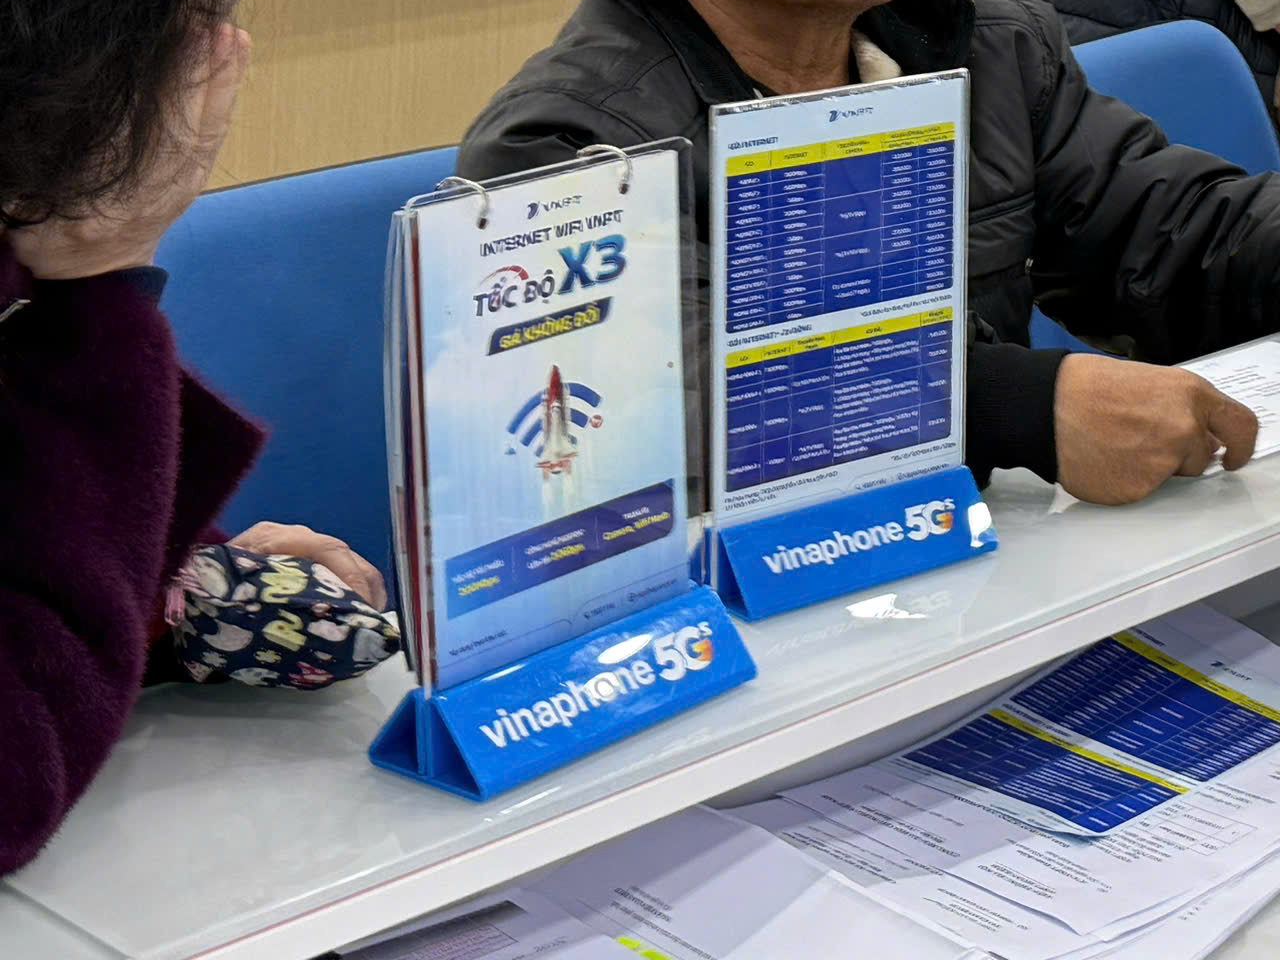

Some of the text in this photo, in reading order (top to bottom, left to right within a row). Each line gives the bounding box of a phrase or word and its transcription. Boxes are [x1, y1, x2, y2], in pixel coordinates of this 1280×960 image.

[480, 227, 552, 257] INTERNET
[558, 234, 628, 296] X3
[762, 520, 905, 575] vinaphone
[478, 659, 657, 749] vinaphone
